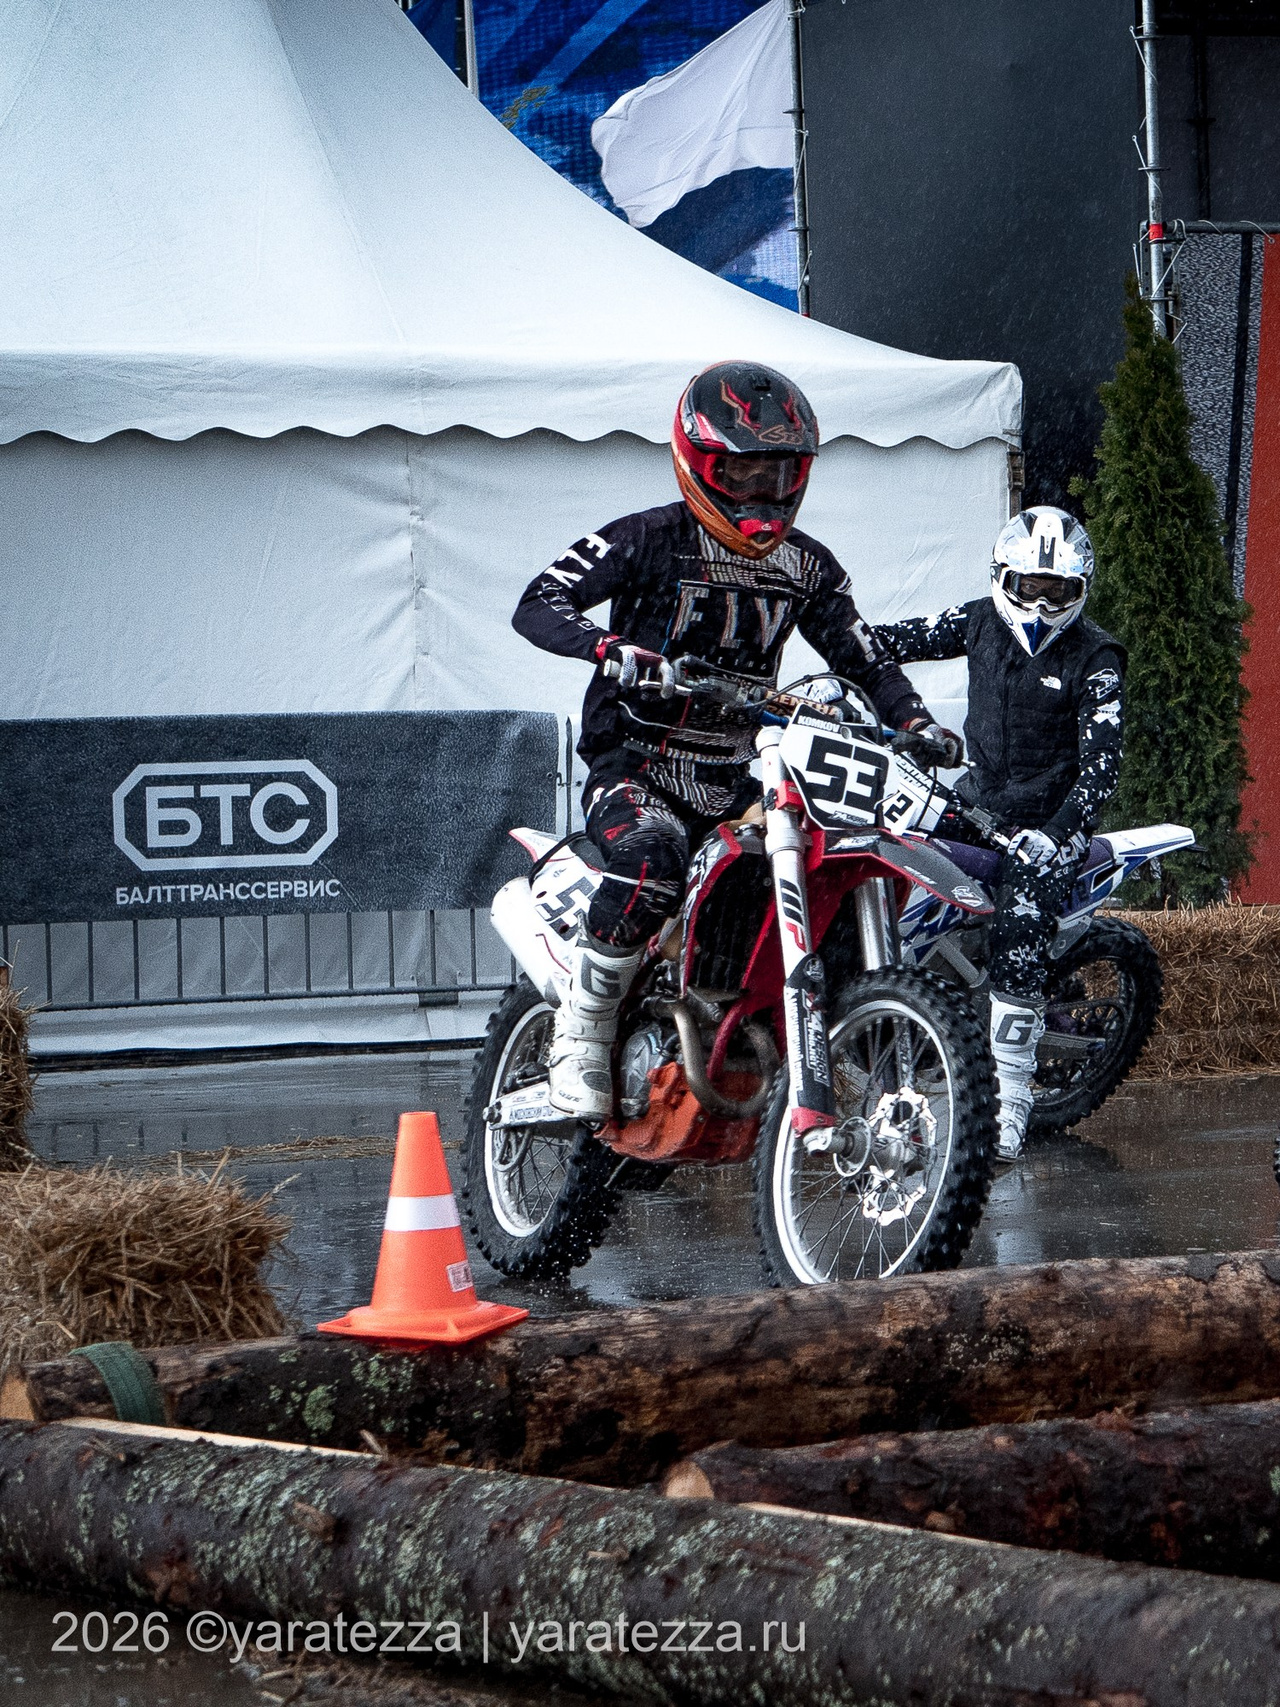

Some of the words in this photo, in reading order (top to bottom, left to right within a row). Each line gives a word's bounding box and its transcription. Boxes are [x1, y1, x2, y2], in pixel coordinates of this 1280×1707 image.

[544, 533, 616, 589] FLY
[701, 655, 768, 671] ACING
[766, 689, 840, 717] RENTHA
[797, 715, 841, 733] KOMKOV
[805, 735, 890, 813] 53
[892, 754, 935, 788] RENTHA
[146, 782, 311, 848] БТС
[884, 793, 914, 823] 2
[115, 879, 341, 905] БАЛТТРАНССЕРВИС
[995, 1014, 1035, 1046] G
